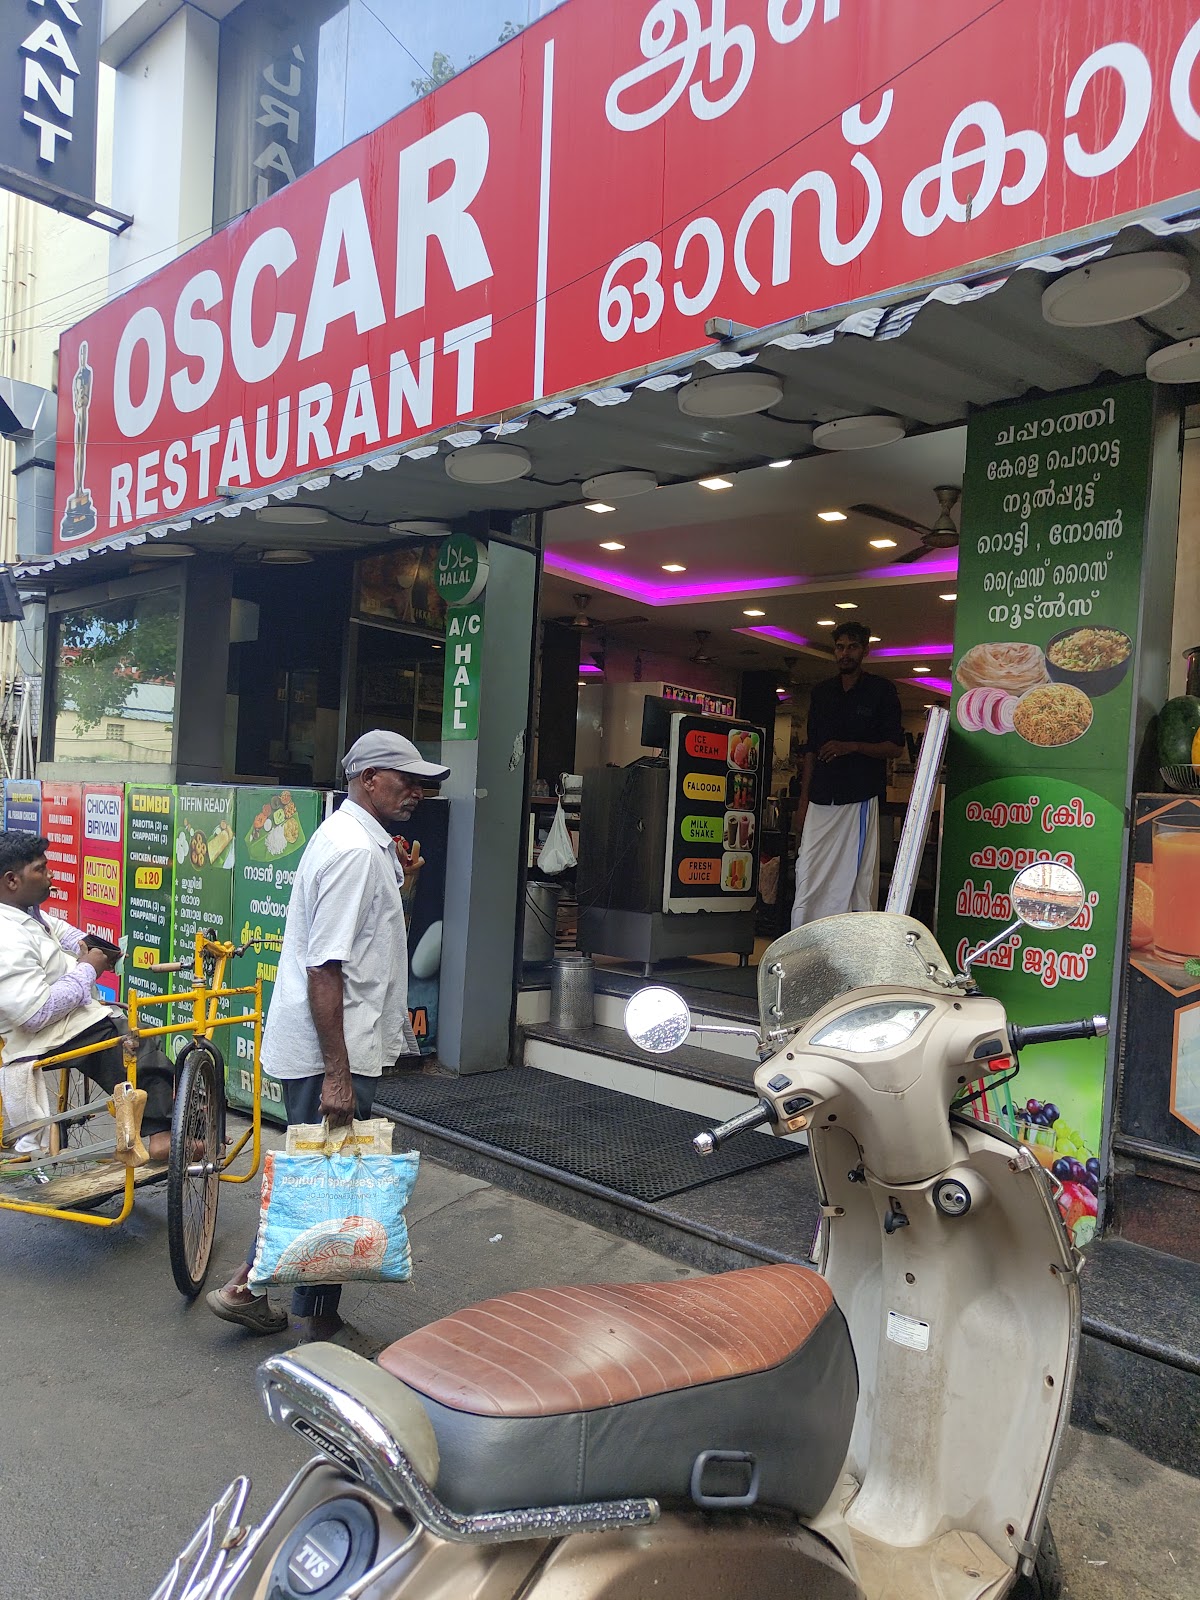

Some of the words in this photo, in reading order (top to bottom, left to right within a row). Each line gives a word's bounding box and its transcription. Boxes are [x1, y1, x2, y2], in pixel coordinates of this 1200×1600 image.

[114, 111, 494, 438] OSCAR
[109, 315, 493, 526] RESTAURANT
[995, 397, 1115, 446] ചപ്പാത്തി
[987, 453, 1039, 480] കേരള
[1047, 439, 1120, 468] പൊറാട്ട
[1003, 473, 1100, 519] നൂൽപ്പുട്ട്
[978, 522, 1028, 556] റൊട്ടി
[1049, 509, 1123, 545] നോൺ
[438, 544, 473, 572] حلال
[1053, 550, 1113, 586] റൈസ്
[439, 570, 471, 586] HALAL
[448, 614, 481, 638] A/C
[453, 643, 472, 730] HALL
[694, 734, 707, 744] ICE
[694, 744, 720, 756] CREAM
[687, 781, 721, 793] FALOODA
[87, 799, 119, 815] CHICKEN
[132, 795, 170, 813] COMBO
[180, 797, 202, 811] TIFFIN
[203, 797, 231, 813] READY
[966, 796, 1040, 828] ഐസ്
[1042, 797, 1096, 833] ക്രീം
[88, 820, 117, 837] BIRIYANI
[132, 819, 154, 830] PAROTTA
[154, 821, 162, 832] (3)
[690, 819, 709, 829] MILK
[132, 831, 160, 843] CHAPPATHI
[160, 834, 168, 845] (3)
[690, 828, 715, 839] SHAKE
[130, 852, 151, 863] CHICKEN
[152, 855, 169, 866] CURRY
[689, 861, 713, 871] FRESH
[86, 861, 117, 880] MUTTON
[244, 864, 274, 883] നാടൻ
[688, 870, 711, 881] JUICE
[86, 882, 116, 902] BIRIYANI
[130, 897, 151, 909] PAROTTA
[130, 909, 157, 923] CHAPPATHI
[87, 923, 113, 943] PRAWN
[133, 931, 144, 941] EGG
[145, 933, 161, 945] CURRY
[1022, 943, 1097, 988] ജൂസ്
[128, 975, 149, 989] PAROTTA
[142, 1013, 163, 1028] CHICKEN
[296, 1544, 330, 1578] TVS
